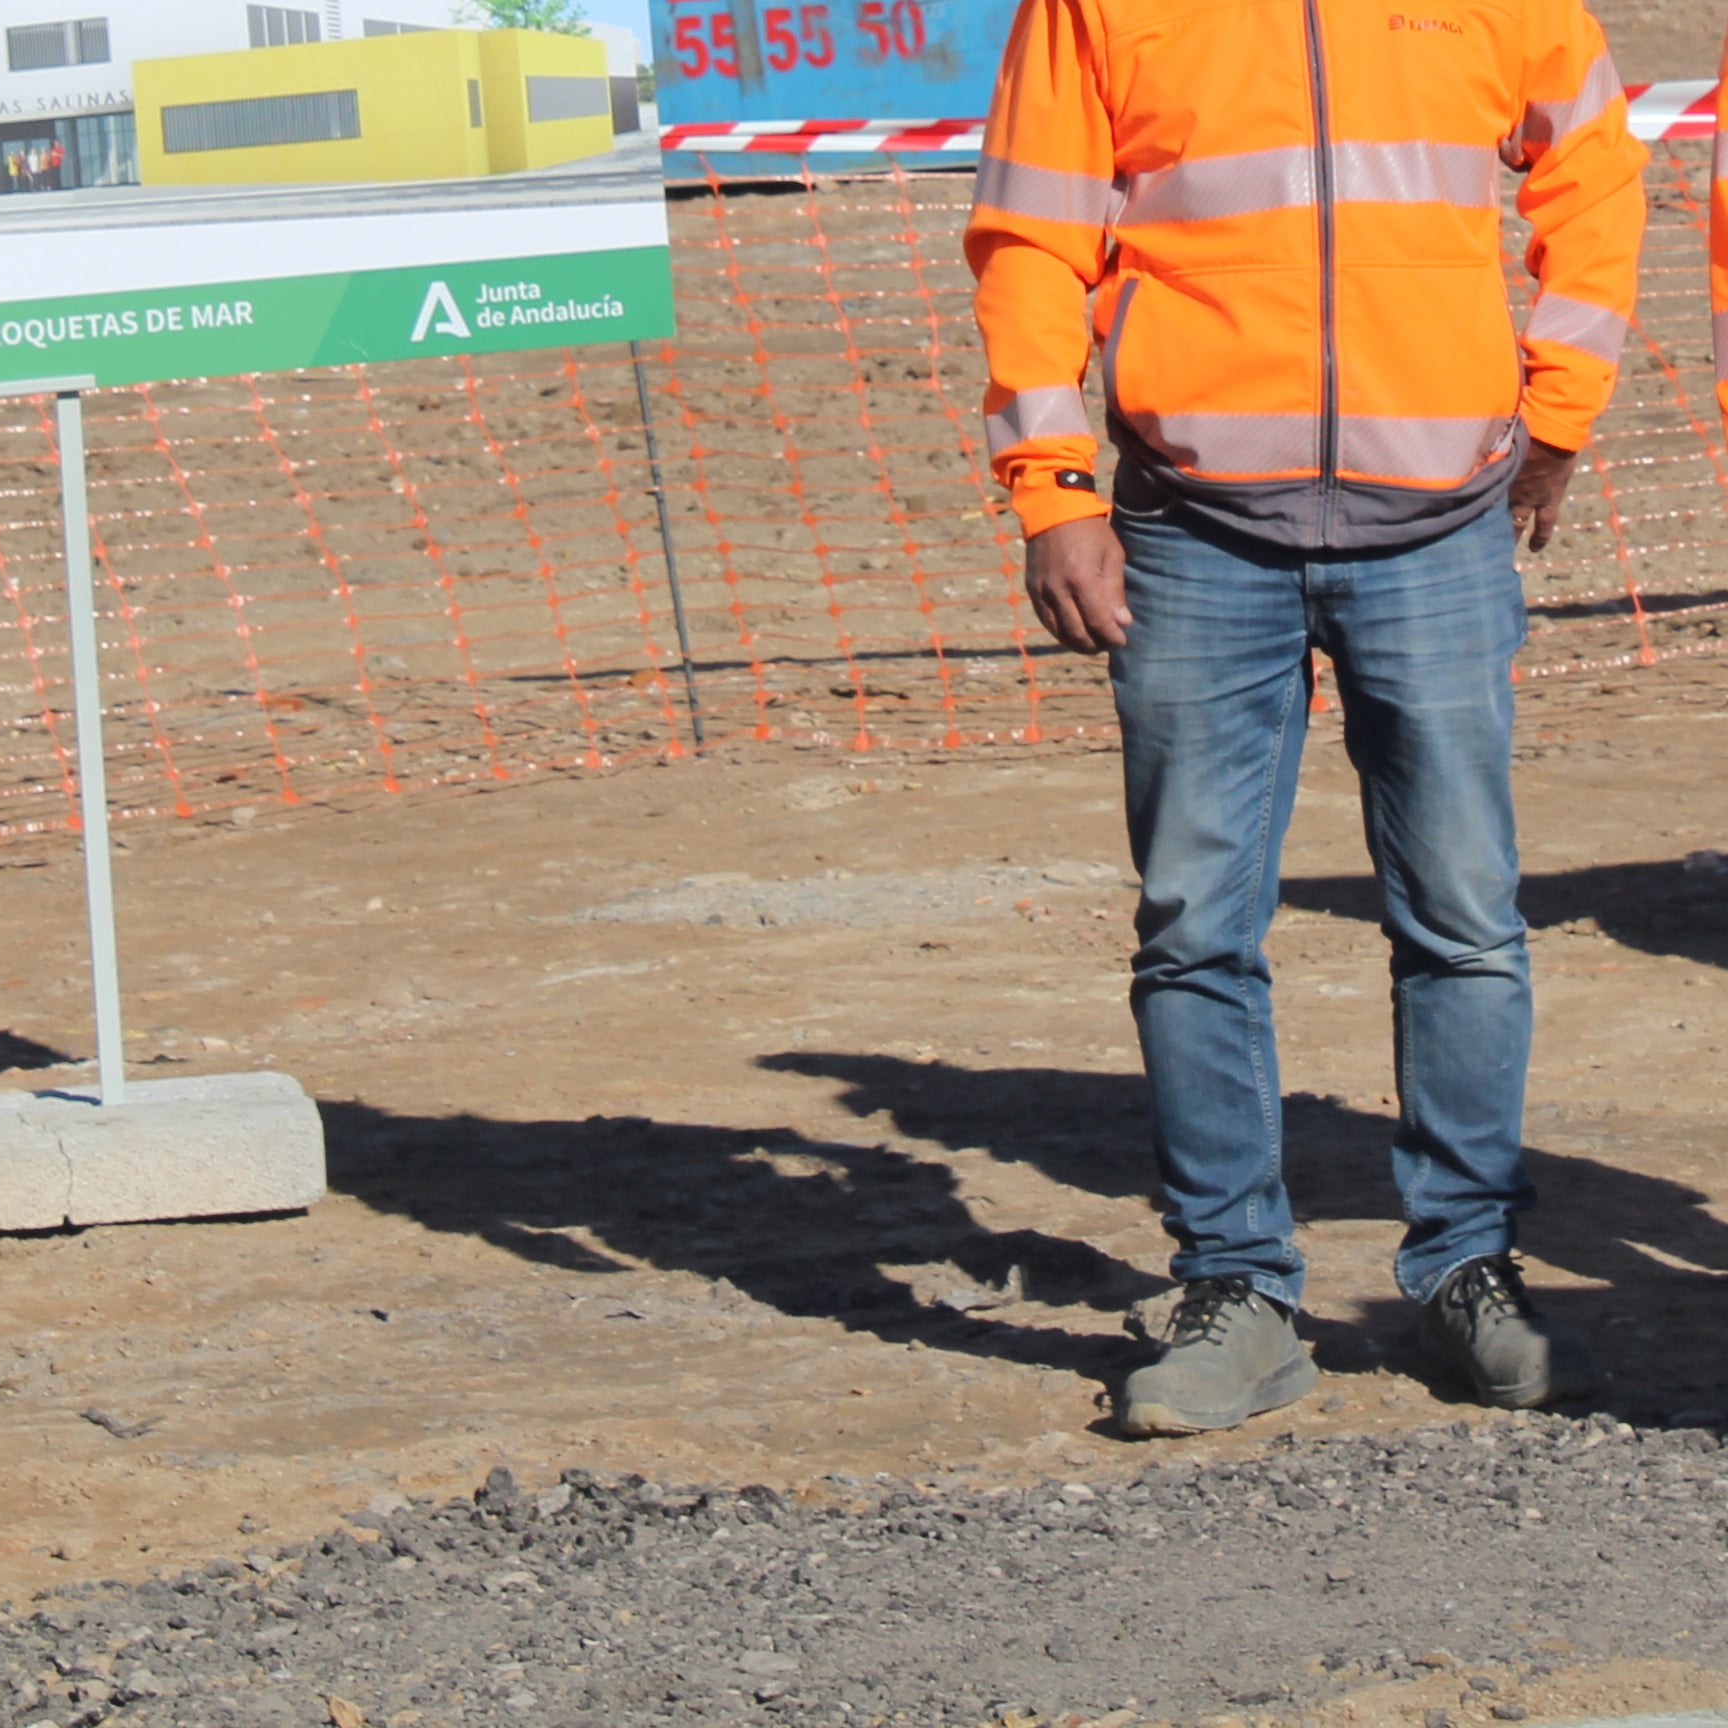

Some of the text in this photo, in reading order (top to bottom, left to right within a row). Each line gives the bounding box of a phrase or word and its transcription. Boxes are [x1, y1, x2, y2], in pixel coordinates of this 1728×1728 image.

[675, 13, 740, 79] 55
[764, 5, 836, 73] 55
[476, 282, 541, 304] Junta
[145, 306, 184, 333] DE
[190, 300, 254, 329] MAR
[476, 294, 624, 328] de Andalucía
